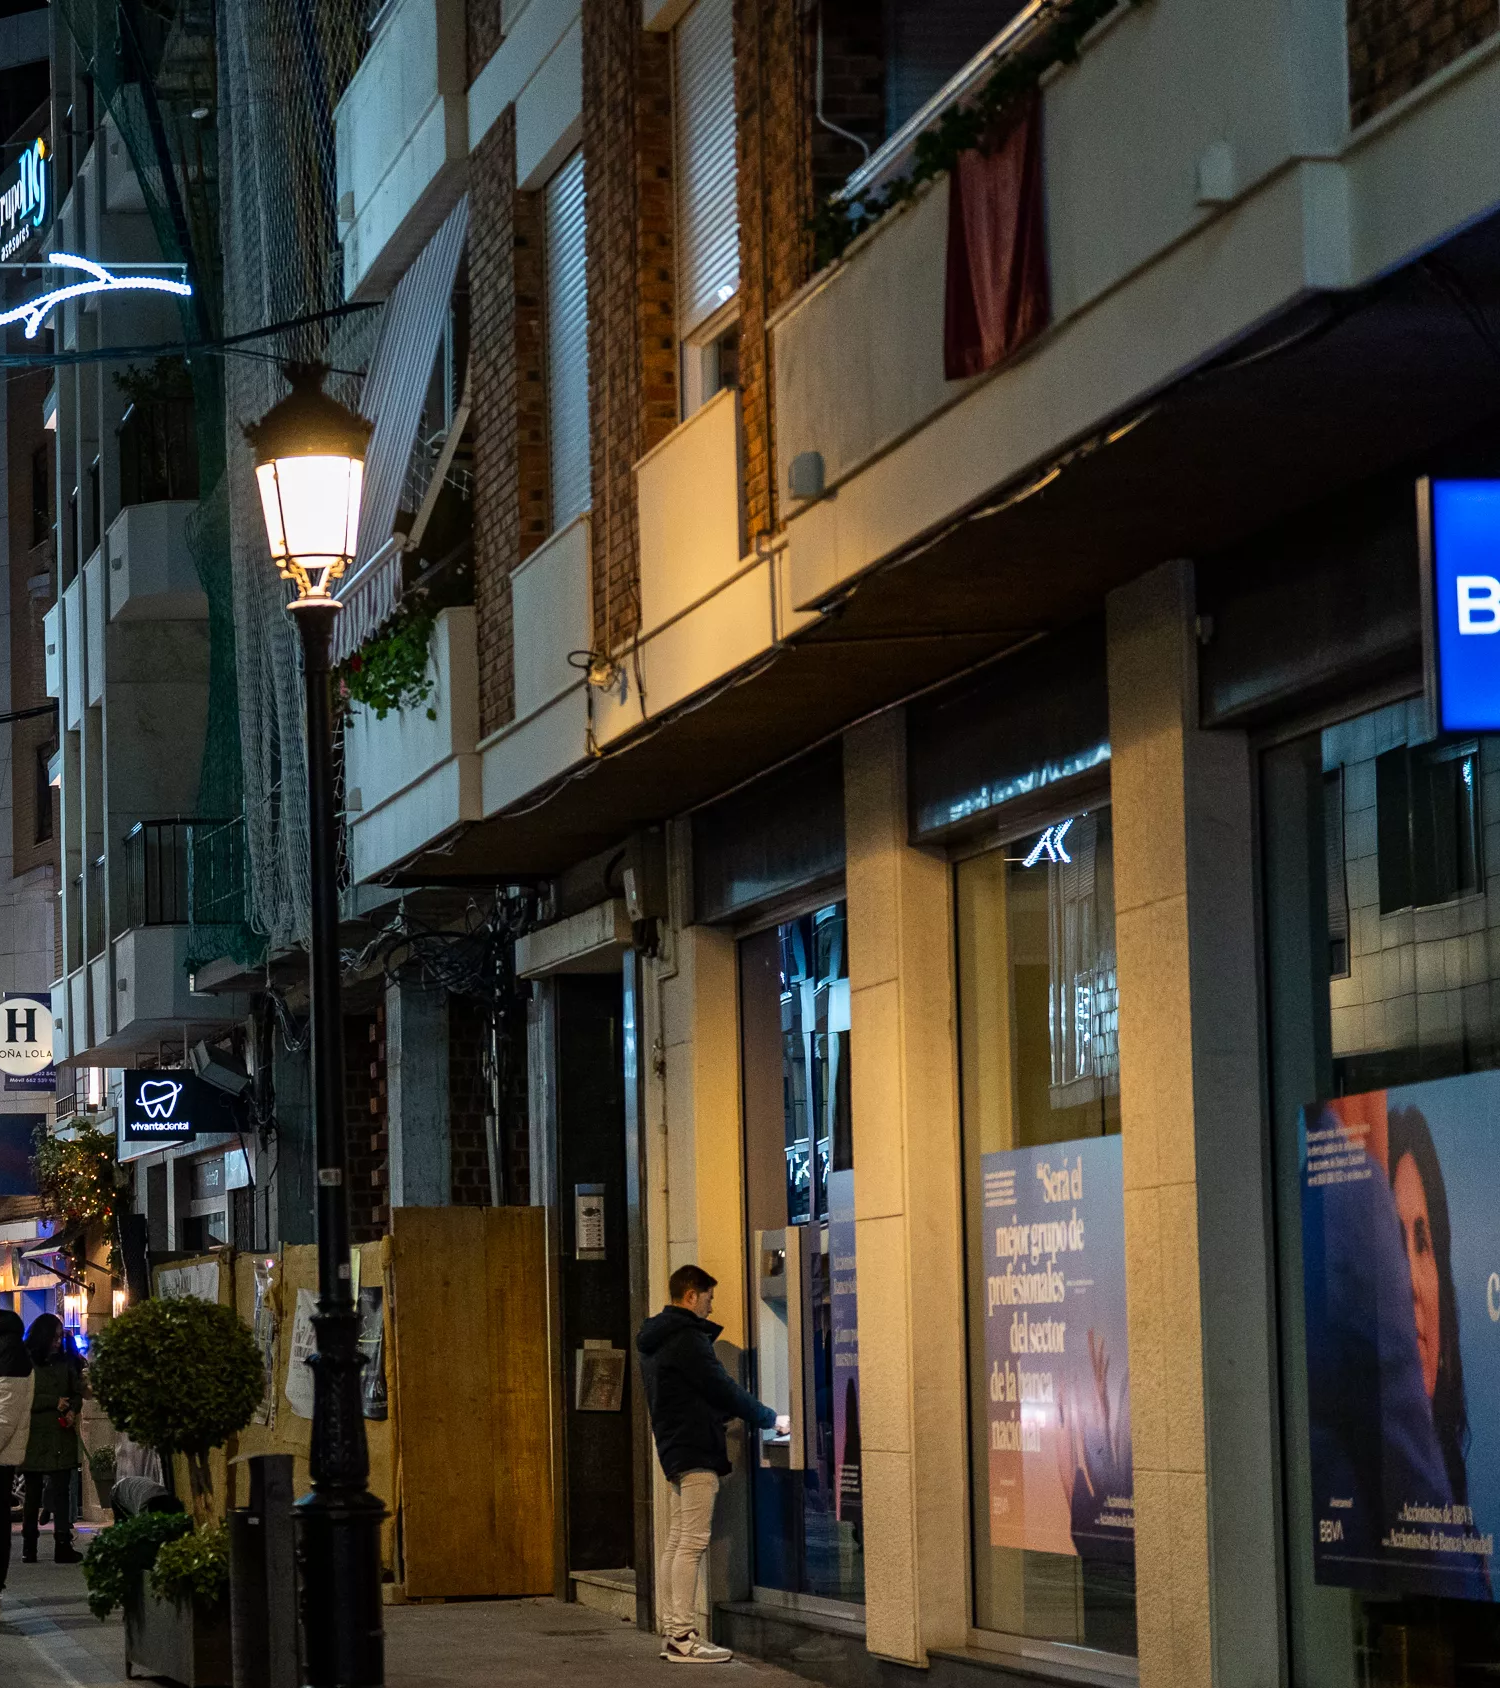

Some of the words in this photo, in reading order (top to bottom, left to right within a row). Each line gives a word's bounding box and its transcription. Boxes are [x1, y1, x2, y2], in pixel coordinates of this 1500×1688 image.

[1, 224, 29, 261] asesores
[5, 1008, 38, 1043] H
[25, 1049, 53, 1058] LOLA
[130, 1121, 190, 1131] vivantadental
[1071, 1156, 1083, 1200] el
[995, 1214, 1029, 1265] mejor
[1030, 1221, 1068, 1266] grupo
[1068, 1207, 1085, 1252] de
[987, 1260, 1065, 1316] profesionales
[1009, 1312, 1028, 1353] del
[1029, 1317, 1066, 1353] sector
[989, 1360, 1005, 1402] de
[1005, 1360, 1017, 1402] la
[1017, 1361, 1053, 1403] banca
[1319, 1519, 1344, 1543] BBVA
